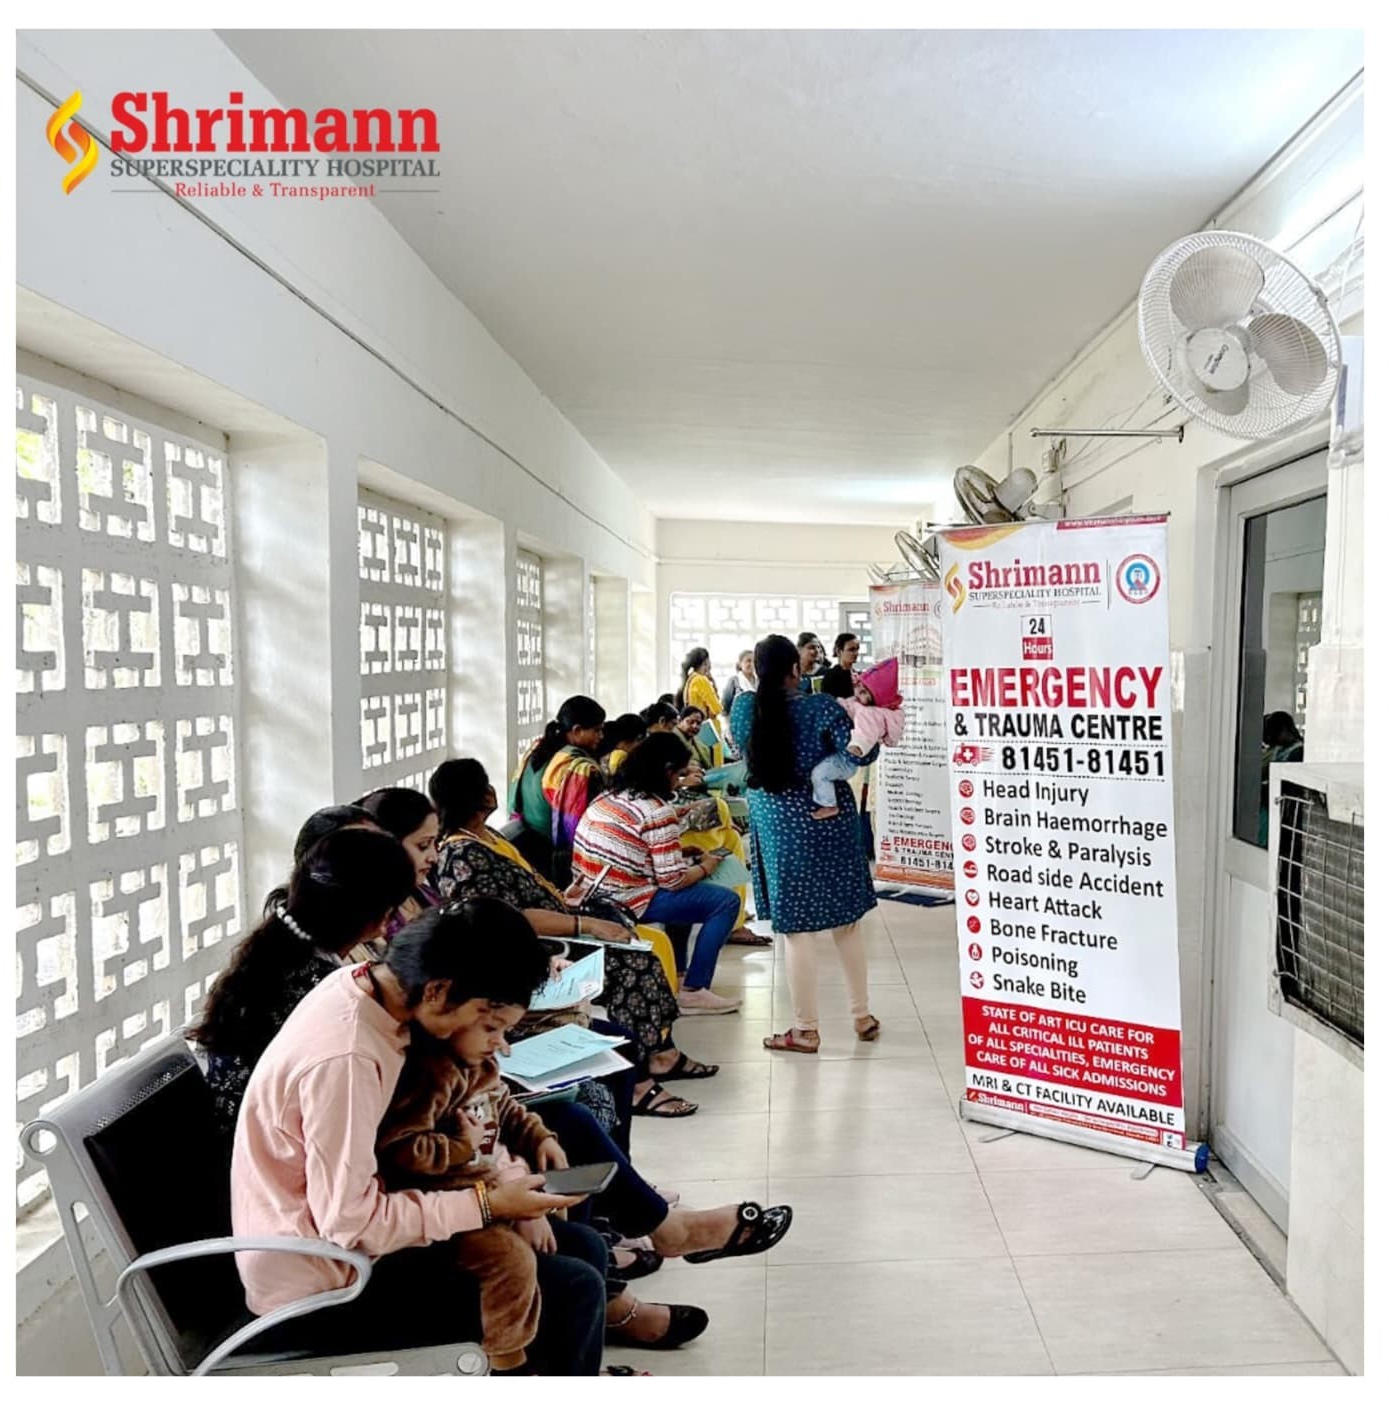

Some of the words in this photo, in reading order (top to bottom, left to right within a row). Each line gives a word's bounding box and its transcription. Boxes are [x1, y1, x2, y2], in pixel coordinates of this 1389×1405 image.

[968, 557, 1102, 590] Shrimann
[968, 587, 1052, 601] SUPERSPECIALITY
[1053, 586, 1102, 598] HOSPITAL
[1028, 617, 1046, 635] 24
[1023, 642, 1053, 656] Hours
[950, 665, 1164, 710] EMERGENCY
[953, 712, 968, 737] &
[974, 712, 1065, 740] TRAUMA
[1070, 713, 1164, 741] CENTRE
[1001, 745, 1165, 777] 81451-81451
[983, 779, 1030, 801] Head
[1035, 781, 1090, 807] Injury
[984, 808, 1031, 828] Brain
[1037, 811, 1168, 841] Haemorrhage
[985, 835, 1043, 857] Stroke
[1048, 838, 1062, 859] &
[1068, 840, 1152, 868] Paralysis
[987, 863, 1032, 885] Road
[1037, 866, 1073, 889] side
[1079, 871, 1164, 898] Accident
[988, 890, 1039, 914] Heart
[1044, 894, 1103, 920] Attack
[990, 917, 1036, 940] Bone
[1041, 922, 1119, 951] Fracture
[991, 945, 1079, 978] Poisoning
[993, 973, 1045, 997] Snake
[1050, 980, 1087, 1004] Bite
[982, 1005, 1017, 1021] STATE
[1019, 1010, 1036, 1023] OF
[1038, 1014, 1062, 1028] ART
[1065, 1019, 1087, 1033] ICU
[1090, 1022, 1124, 1039] CARE
[1127, 1029, 1154, 1045] FOR
[989, 1022, 1010, 1036] ALL
[1012, 1025, 1065, 1047] CRITICAL
[1068, 1035, 1085, 1049] ILL
[1088, 1039, 1148, 1060] PATIENTS
[968, 1033, 985, 1047] OF
[986, 1036, 1008, 1051] ALL
[1010, 1039, 1090, 1067] SPECIALITIES,
[1092, 1056, 1175, 1081] EMERGENCY
[976, 1051, 1007, 1066] CARE
[1009, 1056, 1027, 1069] OF
[1029, 1060, 1050, 1075] ALL
[1052, 1065, 1079, 1081] SICK
[1082, 1071, 1167, 1097] ADMISSIONS
[972, 1073, 999, 1091] MRI
[1001, 1078, 1012, 1092] &
[1016, 1081, 1032, 1097] CT
[1035, 1085, 1093, 1110] FACILITY
[1096, 1098, 1175, 1127] AVAILABLE
